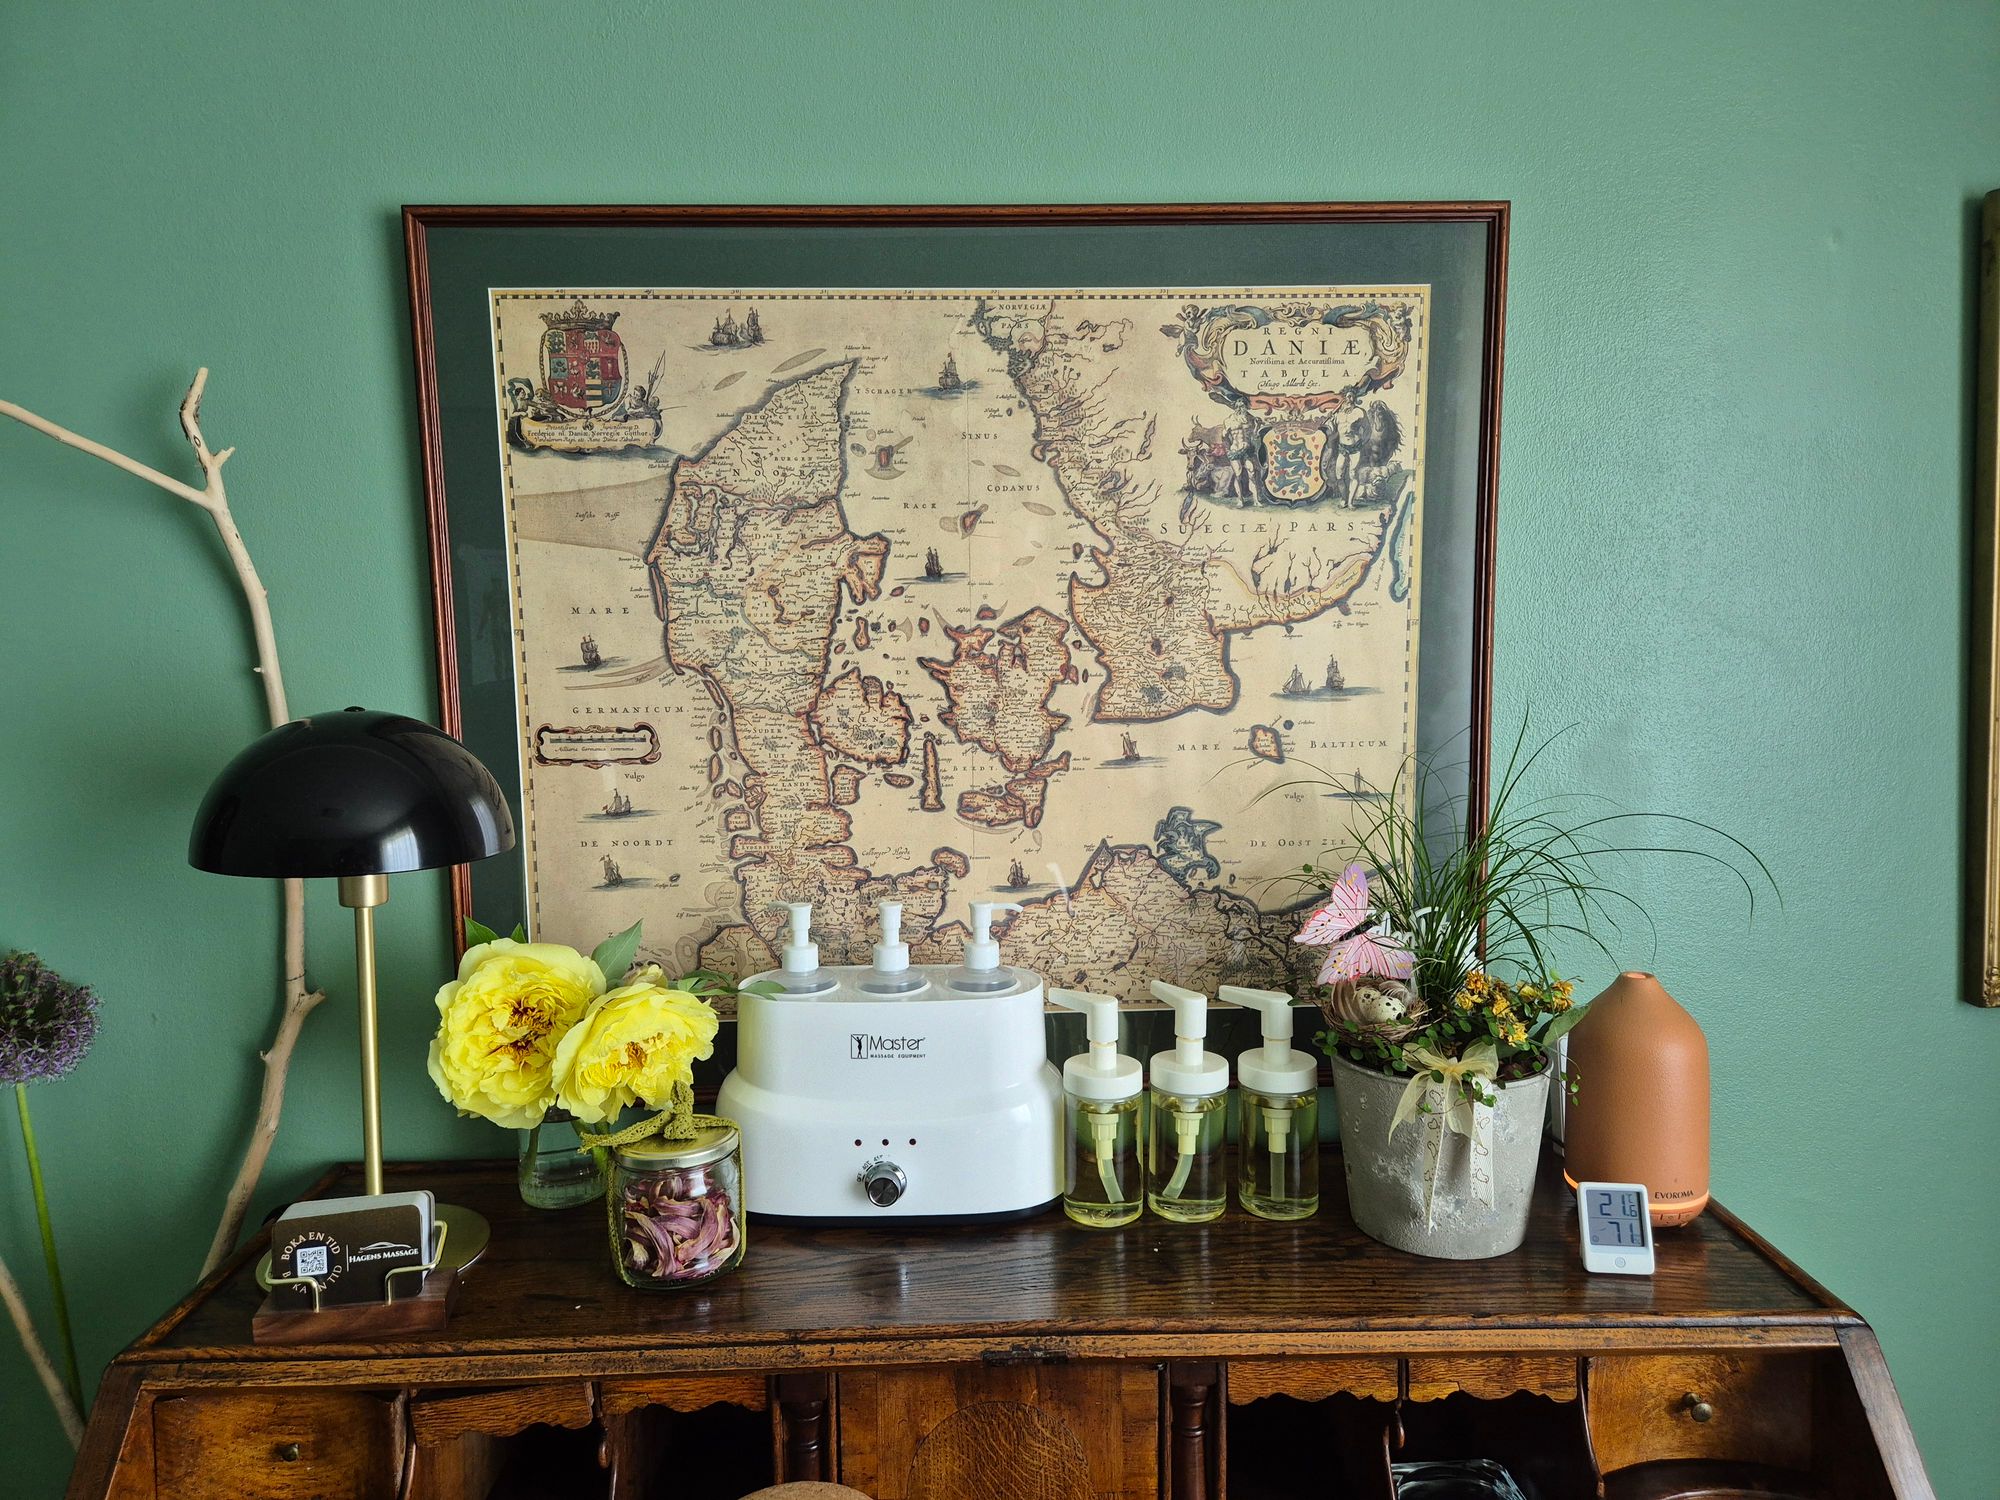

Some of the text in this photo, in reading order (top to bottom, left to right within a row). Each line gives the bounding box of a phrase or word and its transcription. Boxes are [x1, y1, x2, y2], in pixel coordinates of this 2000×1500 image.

[1263, 327, 1333, 336] REGNI
[987, 484, 1040, 492] CODANUS
[571, 607, 630, 615] MARE
[1178, 740, 1387, 752] MARE BALTICUM
[625, 773, 645, 782] Vulgo
[612, 839, 674, 847] NOORDT
[1278, 838, 1311, 847] OOST
[869, 1035, 925, 1051] Master
[1654, 1190, 1694, 1200] EVOROMA
[281, 1231, 341, 1260] BOKA EN TID
[349, 1248, 418, 1263] HAGENS MASSAGE
[282, 1271, 307, 1294] BKA
[327, 1265, 343, 1283] TID
